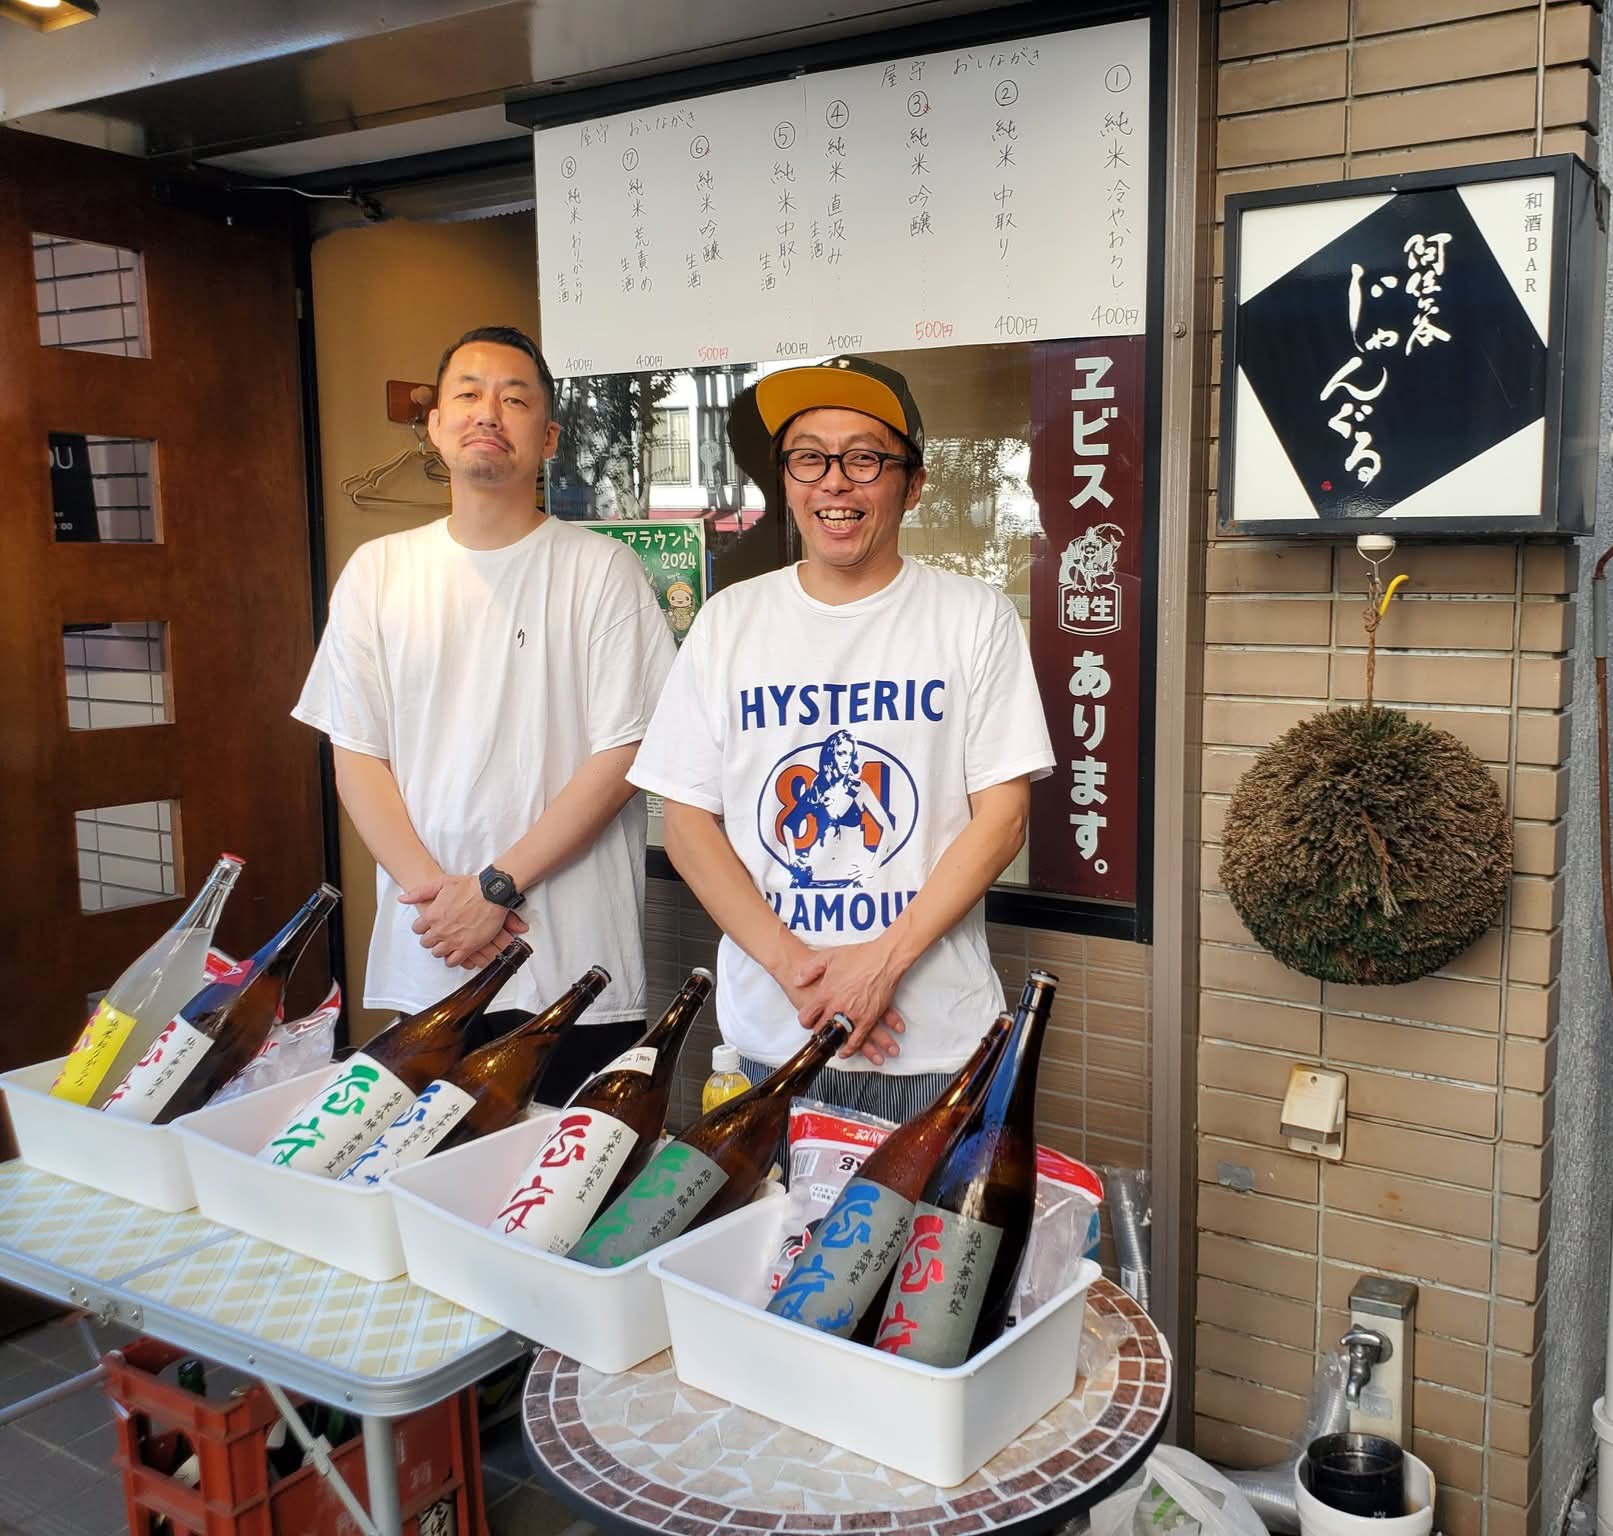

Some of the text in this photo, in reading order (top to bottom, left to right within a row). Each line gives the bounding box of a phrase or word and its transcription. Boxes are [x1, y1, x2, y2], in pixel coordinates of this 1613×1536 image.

[880, 46, 1040, 89] 屋守 おしながき
[629, 108, 697, 138] おしながき
[994, 315, 1038, 337] 400円
[1090, 305, 1139, 329] 400円
[915, 320, 953, 341] 500円
[697, 346, 729, 362] 500円
[775, 341, 808, 356] 400円
[827, 334, 862, 351] 400円
[565, 357, 593, 372] 400円
[635, 354, 663, 369] 400円
[1319, 263, 1399, 489] じゃんぐる
[660, 552, 697, 570] 2024
[1066, 595, 1115, 622] 樽生
[740, 679, 946, 731] HYSTERIC
[1068, 650, 1112, 875] あります。
[765, 890, 919, 933] LAMOU
